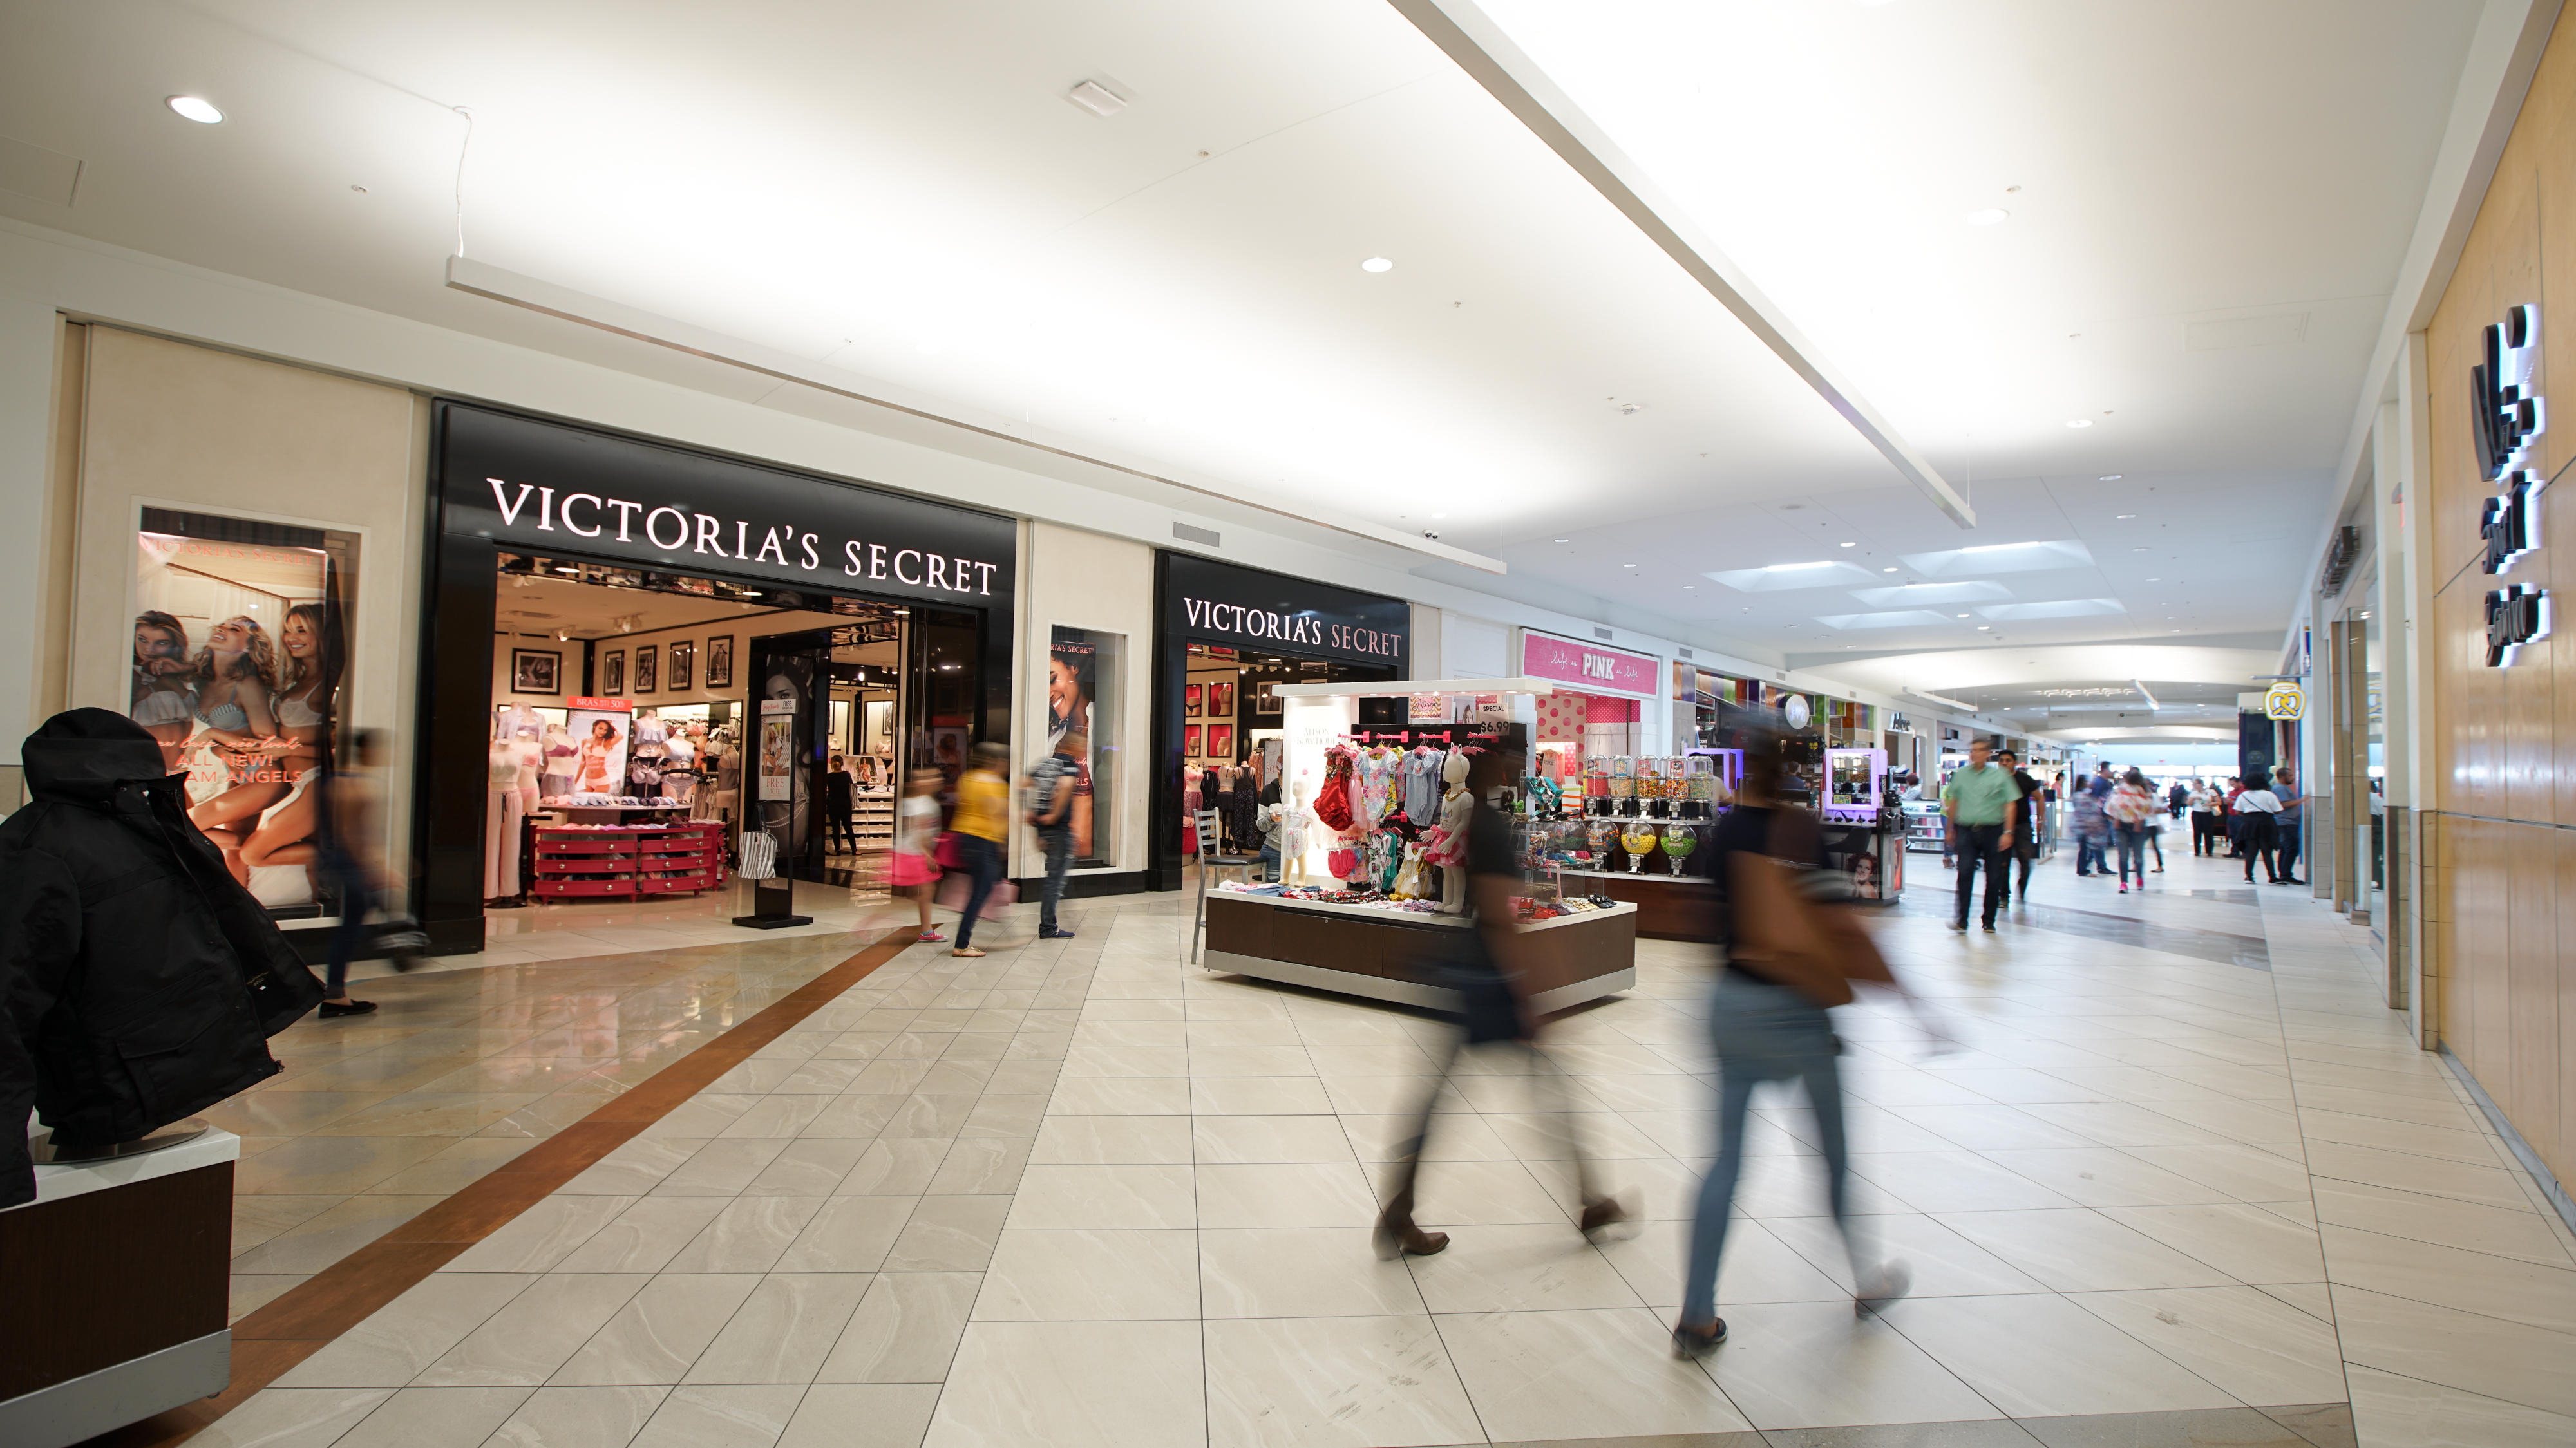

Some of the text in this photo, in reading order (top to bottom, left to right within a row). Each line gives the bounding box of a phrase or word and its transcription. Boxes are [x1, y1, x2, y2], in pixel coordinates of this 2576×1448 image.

[486, 478, 997, 596] VICTORIA'S SECRET
[140, 537, 314, 566] VICTORIA'S SECRET
[1183, 597, 1401, 657] VICTORIA'S SECRET
[1068, 644, 1092, 654] SECRET
[1551, 651, 1567, 670] life
[1582, 652, 1615, 681] PINK
[1624, 666, 1638, 682] life
[576, 698, 598, 707] BRAS
[1481, 721, 1509, 733] $6.99
[175, 753, 274, 767] ALL NEW!
[226, 770, 303, 783] ANGELS
[766, 777, 784, 788] FREE
